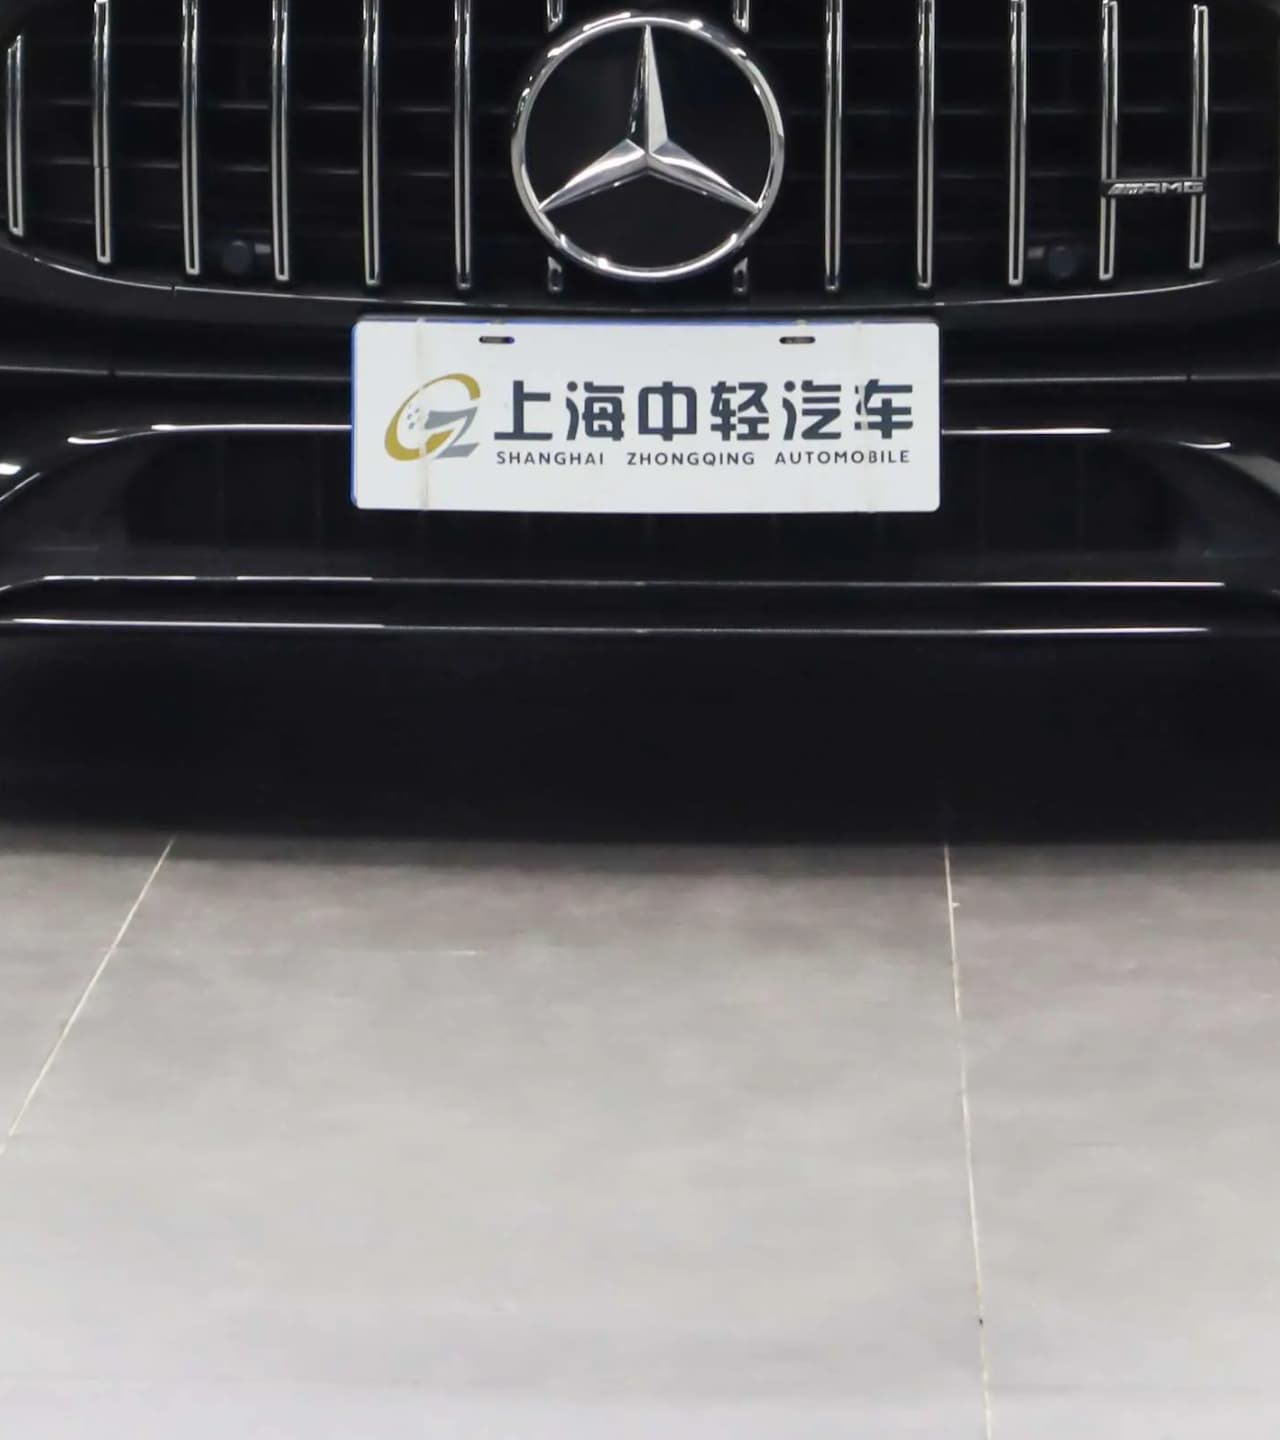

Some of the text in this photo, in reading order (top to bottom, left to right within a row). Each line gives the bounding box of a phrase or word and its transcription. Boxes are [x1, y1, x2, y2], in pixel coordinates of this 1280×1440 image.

[1136, 181, 1204, 195] AMG
[494, 378, 914, 442] 上海中轻汽车
[496, 450, 910, 467] SHANGHAI ZHONGQING AUTOMOBILE
